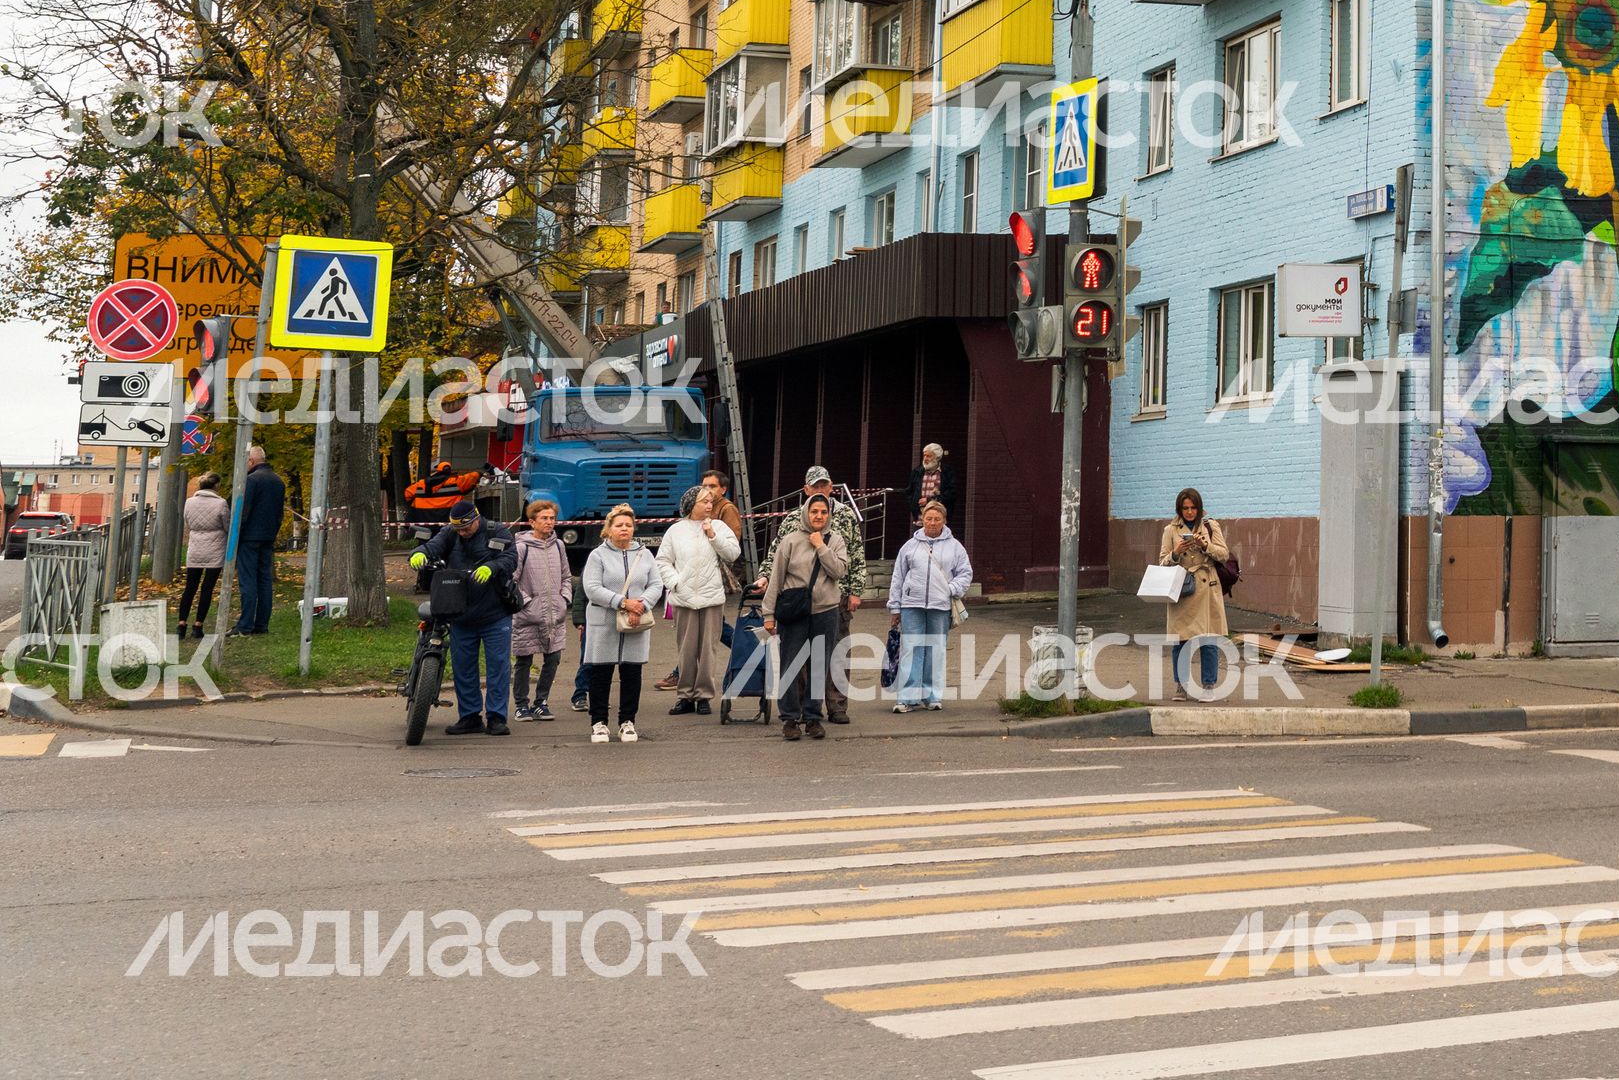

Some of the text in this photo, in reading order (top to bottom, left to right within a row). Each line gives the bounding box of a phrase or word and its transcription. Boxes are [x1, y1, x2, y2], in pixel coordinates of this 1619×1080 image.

[127, 255, 262, 283] ВНИМА
[177, 303, 240, 320] ереди
[1076, 307, 1108, 336] 21
